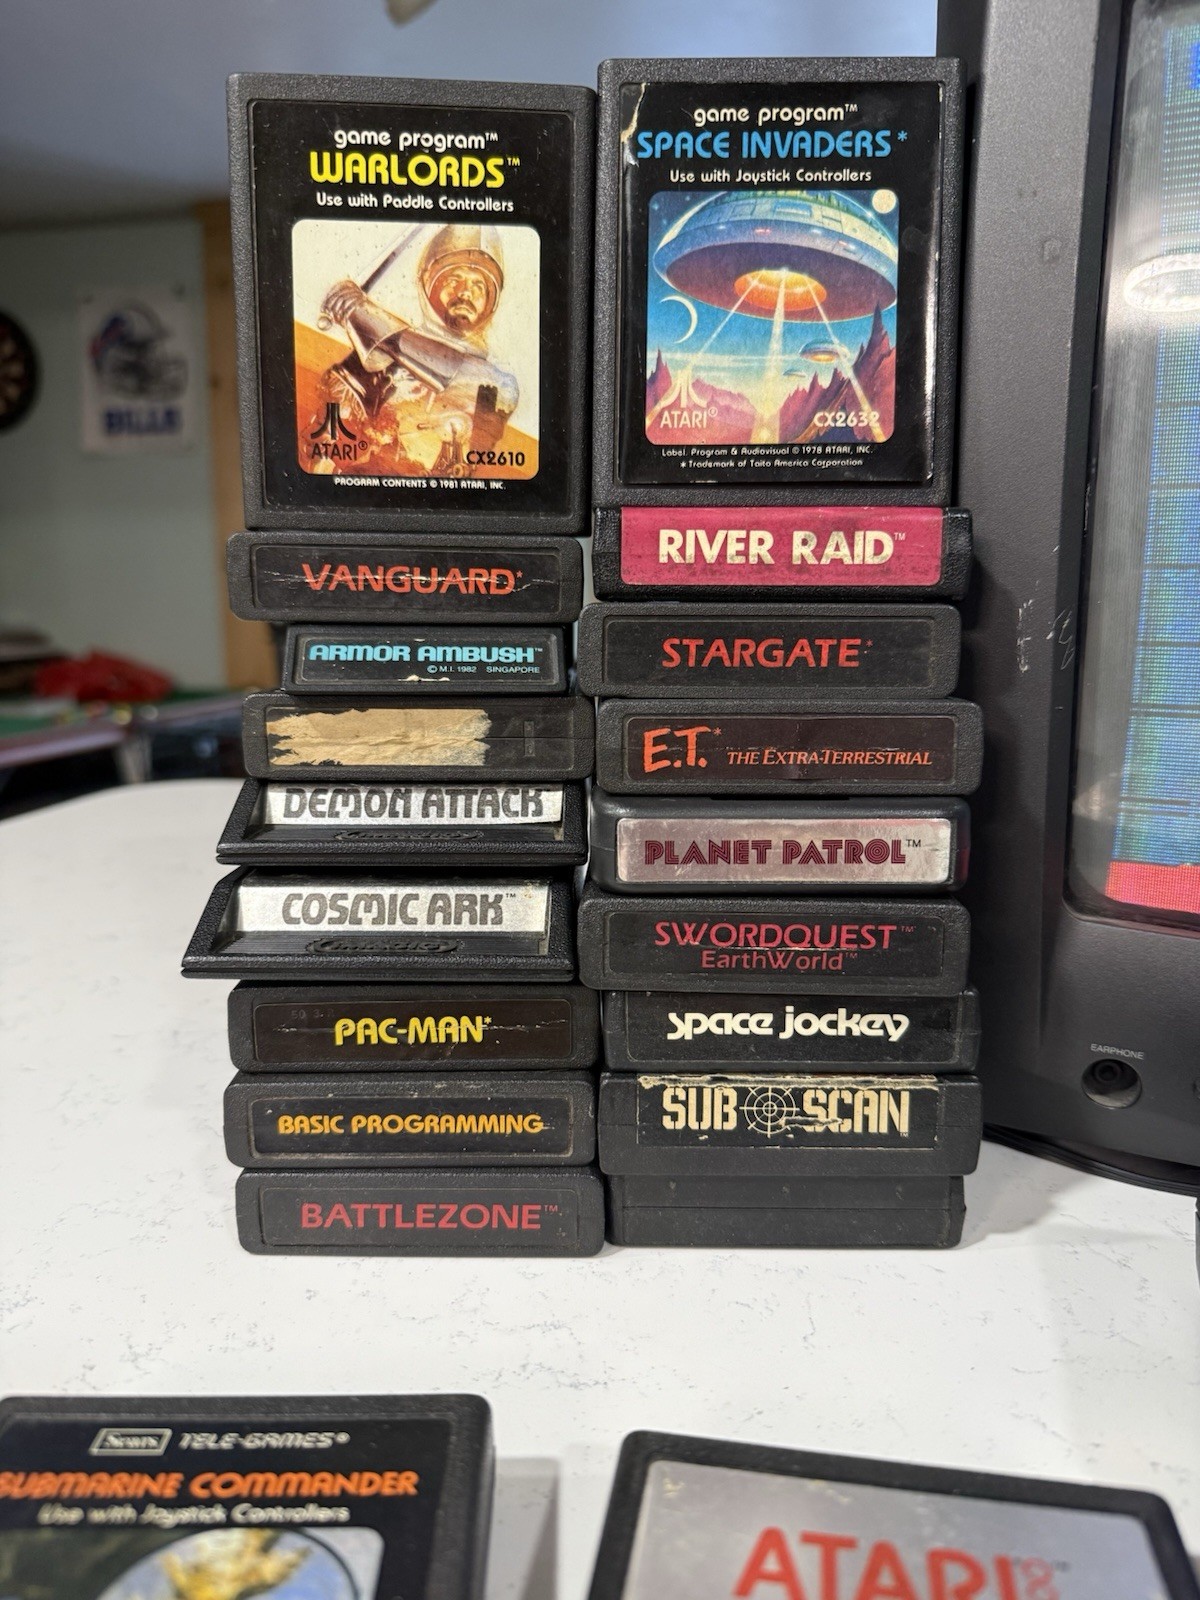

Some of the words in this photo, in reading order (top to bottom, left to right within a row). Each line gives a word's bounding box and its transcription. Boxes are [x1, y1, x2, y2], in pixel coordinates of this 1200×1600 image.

[693, 106, 750, 127] game
[334, 130, 392, 149] game
[637, 130, 730, 159] SPACE
[670, 169, 696, 183] Use
[701, 168, 731, 182] with
[736, 169, 791, 185] Joystick
[796, 168, 872, 182] Controllers
[316, 192, 343, 206] Use
[348, 193, 379, 208] with
[383, 194, 434, 210] Paddle
[439, 197, 514, 212] Controllers
[466, 450, 526, 467] CX2610
[690, 447, 728, 458] Program
[741, 446, 790, 455] Audiovisual
[802, 445, 822, 454] 1978
[737, 459, 747, 468] of
[750, 459, 772, 468] Taito
[773, 459, 809, 467] America
[811, 458, 864, 469] Corporation
[334, 477, 380, 487] PROGRAM
[382, 478, 427, 488] CONTENTS
[440, 480, 458, 488] 1981
[658, 529, 775, 564] RIVER
[309, 644, 411, 662] ARMOR
[486, 666, 540, 674] SINGAPORE
[727, 751, 761, 765] THE
[283, 787, 413, 819] DEMON
[644, 839, 773, 865] PLANET
[281, 893, 420, 926] COSMIC
[666, 1011, 774, 1041] space
[779, 1005, 911, 1042] jockey
[1090, 1043, 1145, 1060] EARPHONE
[661, 1086, 738, 1131] SUB
[277, 1114, 345, 1134] BASIC
[350, 1114, 544, 1134] PROGRAMMING
[0, 1471, 184, 1500] SUBMARINE
[189, 1470, 419, 1498] COMMANDER
[37, 1502, 85, 1526] Use
[86, 1503, 138, 1525] with
[138, 1503, 227, 1529] Joystick
[230, 1502, 351, 1524] Controllers
